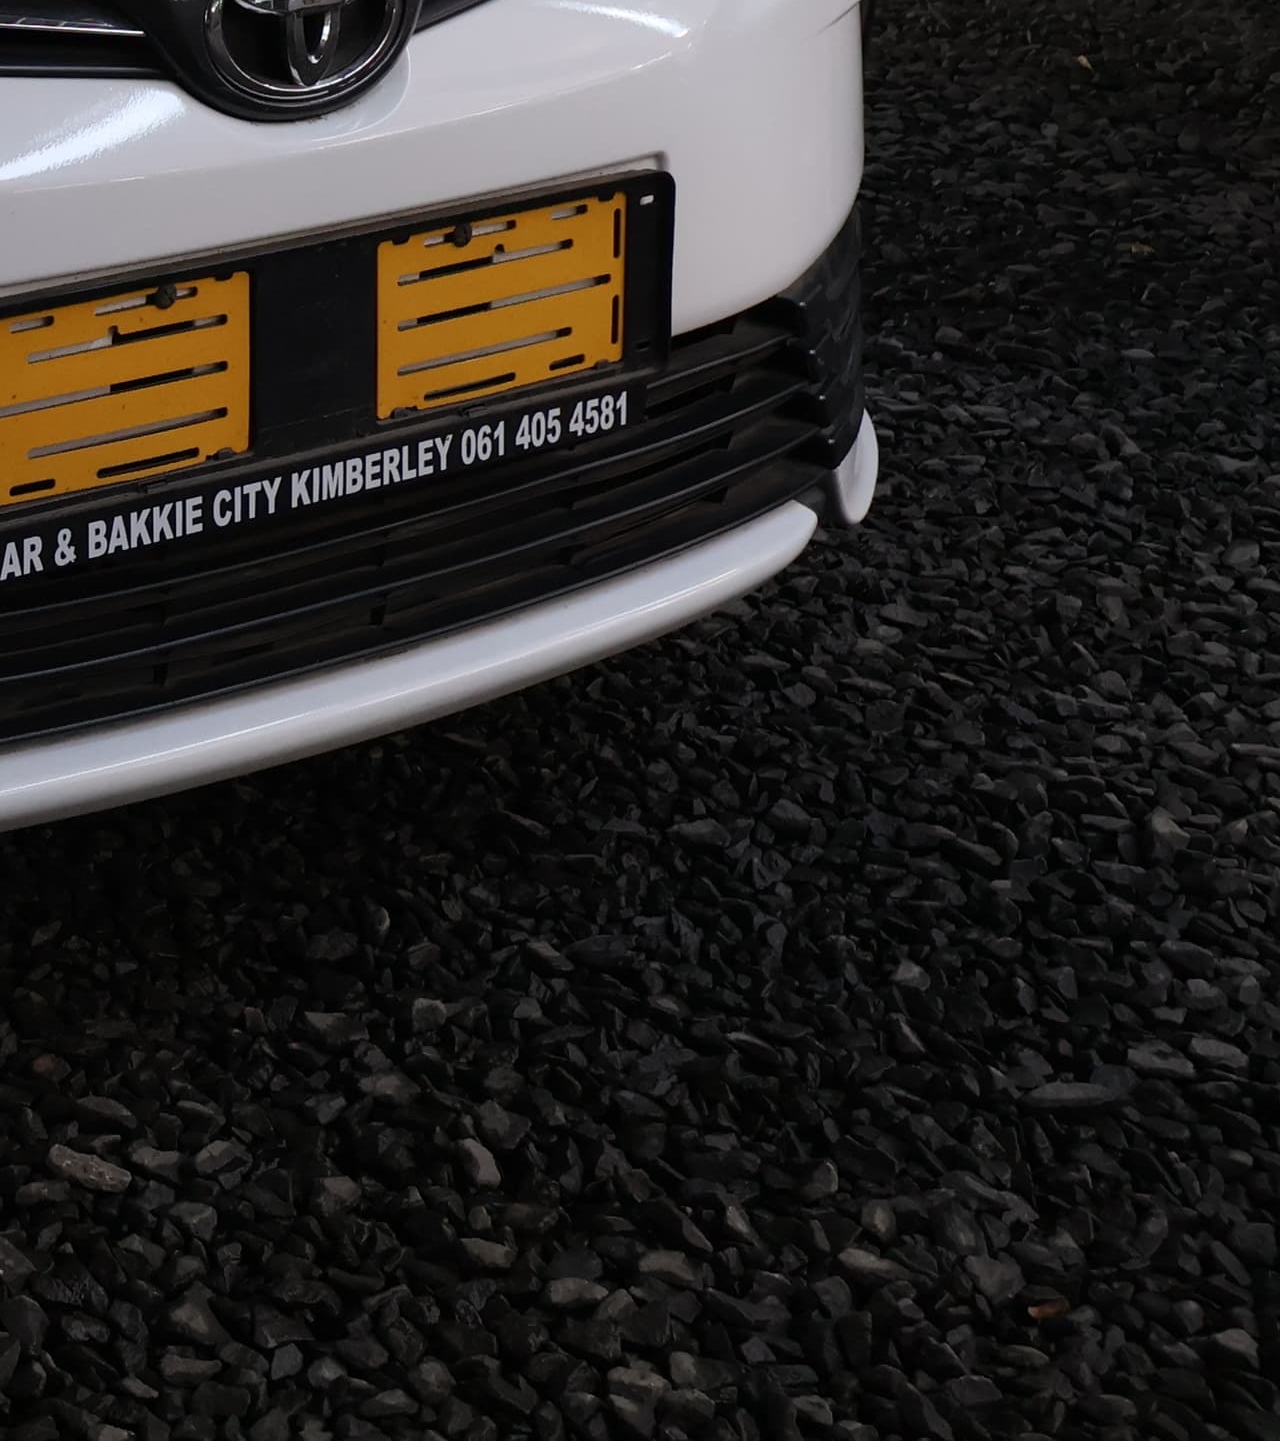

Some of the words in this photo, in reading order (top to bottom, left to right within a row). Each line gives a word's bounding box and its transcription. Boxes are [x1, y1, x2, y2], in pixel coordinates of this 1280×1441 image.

[54, 528, 77, 567] &
[88, 495, 204, 559] BAKKIE
[212, 476, 282, 527] CITY
[290, 433, 453, 508] KIMBERLEY
[460, 420, 506, 465] 061
[515, 407, 562, 450] 405
[569, 390, 628, 437] 4581
